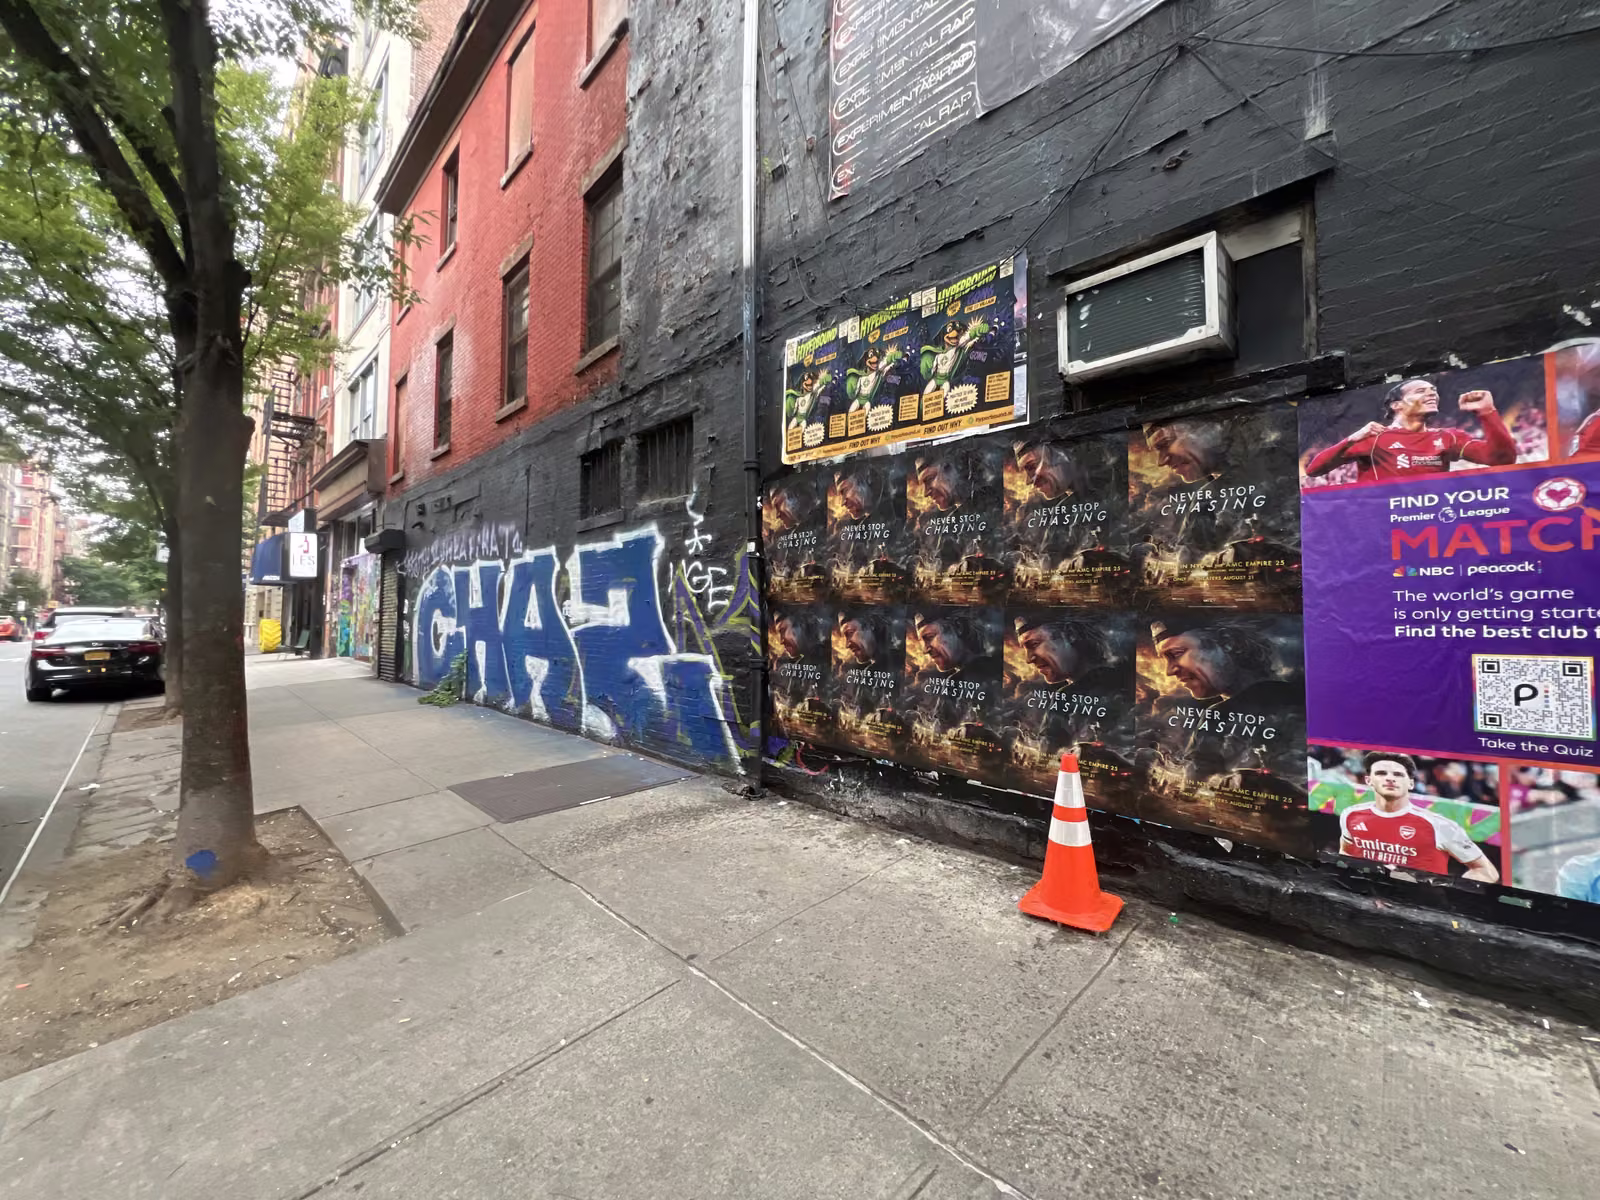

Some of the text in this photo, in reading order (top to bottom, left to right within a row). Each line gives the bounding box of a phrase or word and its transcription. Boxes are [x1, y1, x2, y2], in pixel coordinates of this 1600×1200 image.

[940, 7, 975, 39] RAP
[839, 0, 939, 78] EXPEIMENTAL
[938, 90, 972, 121] RAP
[924, 425, 936, 435] FIND
[937, 423, 949, 432] OUT
[949, 420, 962, 429] WHY
[849, 441, 859, 449] FIND
[1168, 485, 1256, 504] NEVER STOP
[1389, 486, 1510, 510] FIND YOUR
[1033, 502, 1100, 517] NEVER STOP
[1160, 495, 1266, 516] CHASING
[930, 514, 980, 526] NEVER STOP
[1027, 510, 1107, 529] CHASING
[1390, 506, 1510, 523] Premier League
[840, 529, 890, 541] CHASING
[844, 522, 886, 532] NEVER STOP
[925, 521, 987, 535] CHASING
[777, 536, 817, 549] CHASING
[779, 532, 799, 542] NEVER
[1419, 561, 1535, 577] NBC peacock
[1392, 588, 1575, 605] The world's game
[1394, 606, 1600, 622] is only getting start
[1395, 625, 1436, 638] Find
[1441, 625, 1476, 638] the
[1482, 625, 1532, 638] best
[1538, 625, 1588, 639] club
[780, 669, 821, 680] CHASING
[849, 668, 891, 679] NEVER STOP
[846, 675, 895, 689] CHASING
[928, 677, 980, 690] NEVER STOP
[924, 684, 986, 700] CHASING
[1033, 689, 1100, 705] NEVER STOP
[1027, 697, 1107, 718] CHASING
[1176, 706, 1266, 725] NEVER STOP
[1168, 716, 1276, 740] CHASING
[1478, 737, 1594, 758] Take the Quiz
[1089, 761, 1109, 769] EMPIRE
[1232, 788, 1250, 796] AMC
[1252, 791, 1280, 801] EMPIRE
[1353, 836, 1418, 857] Emirates
[1362, 849, 1408, 864] FLY BETTER
